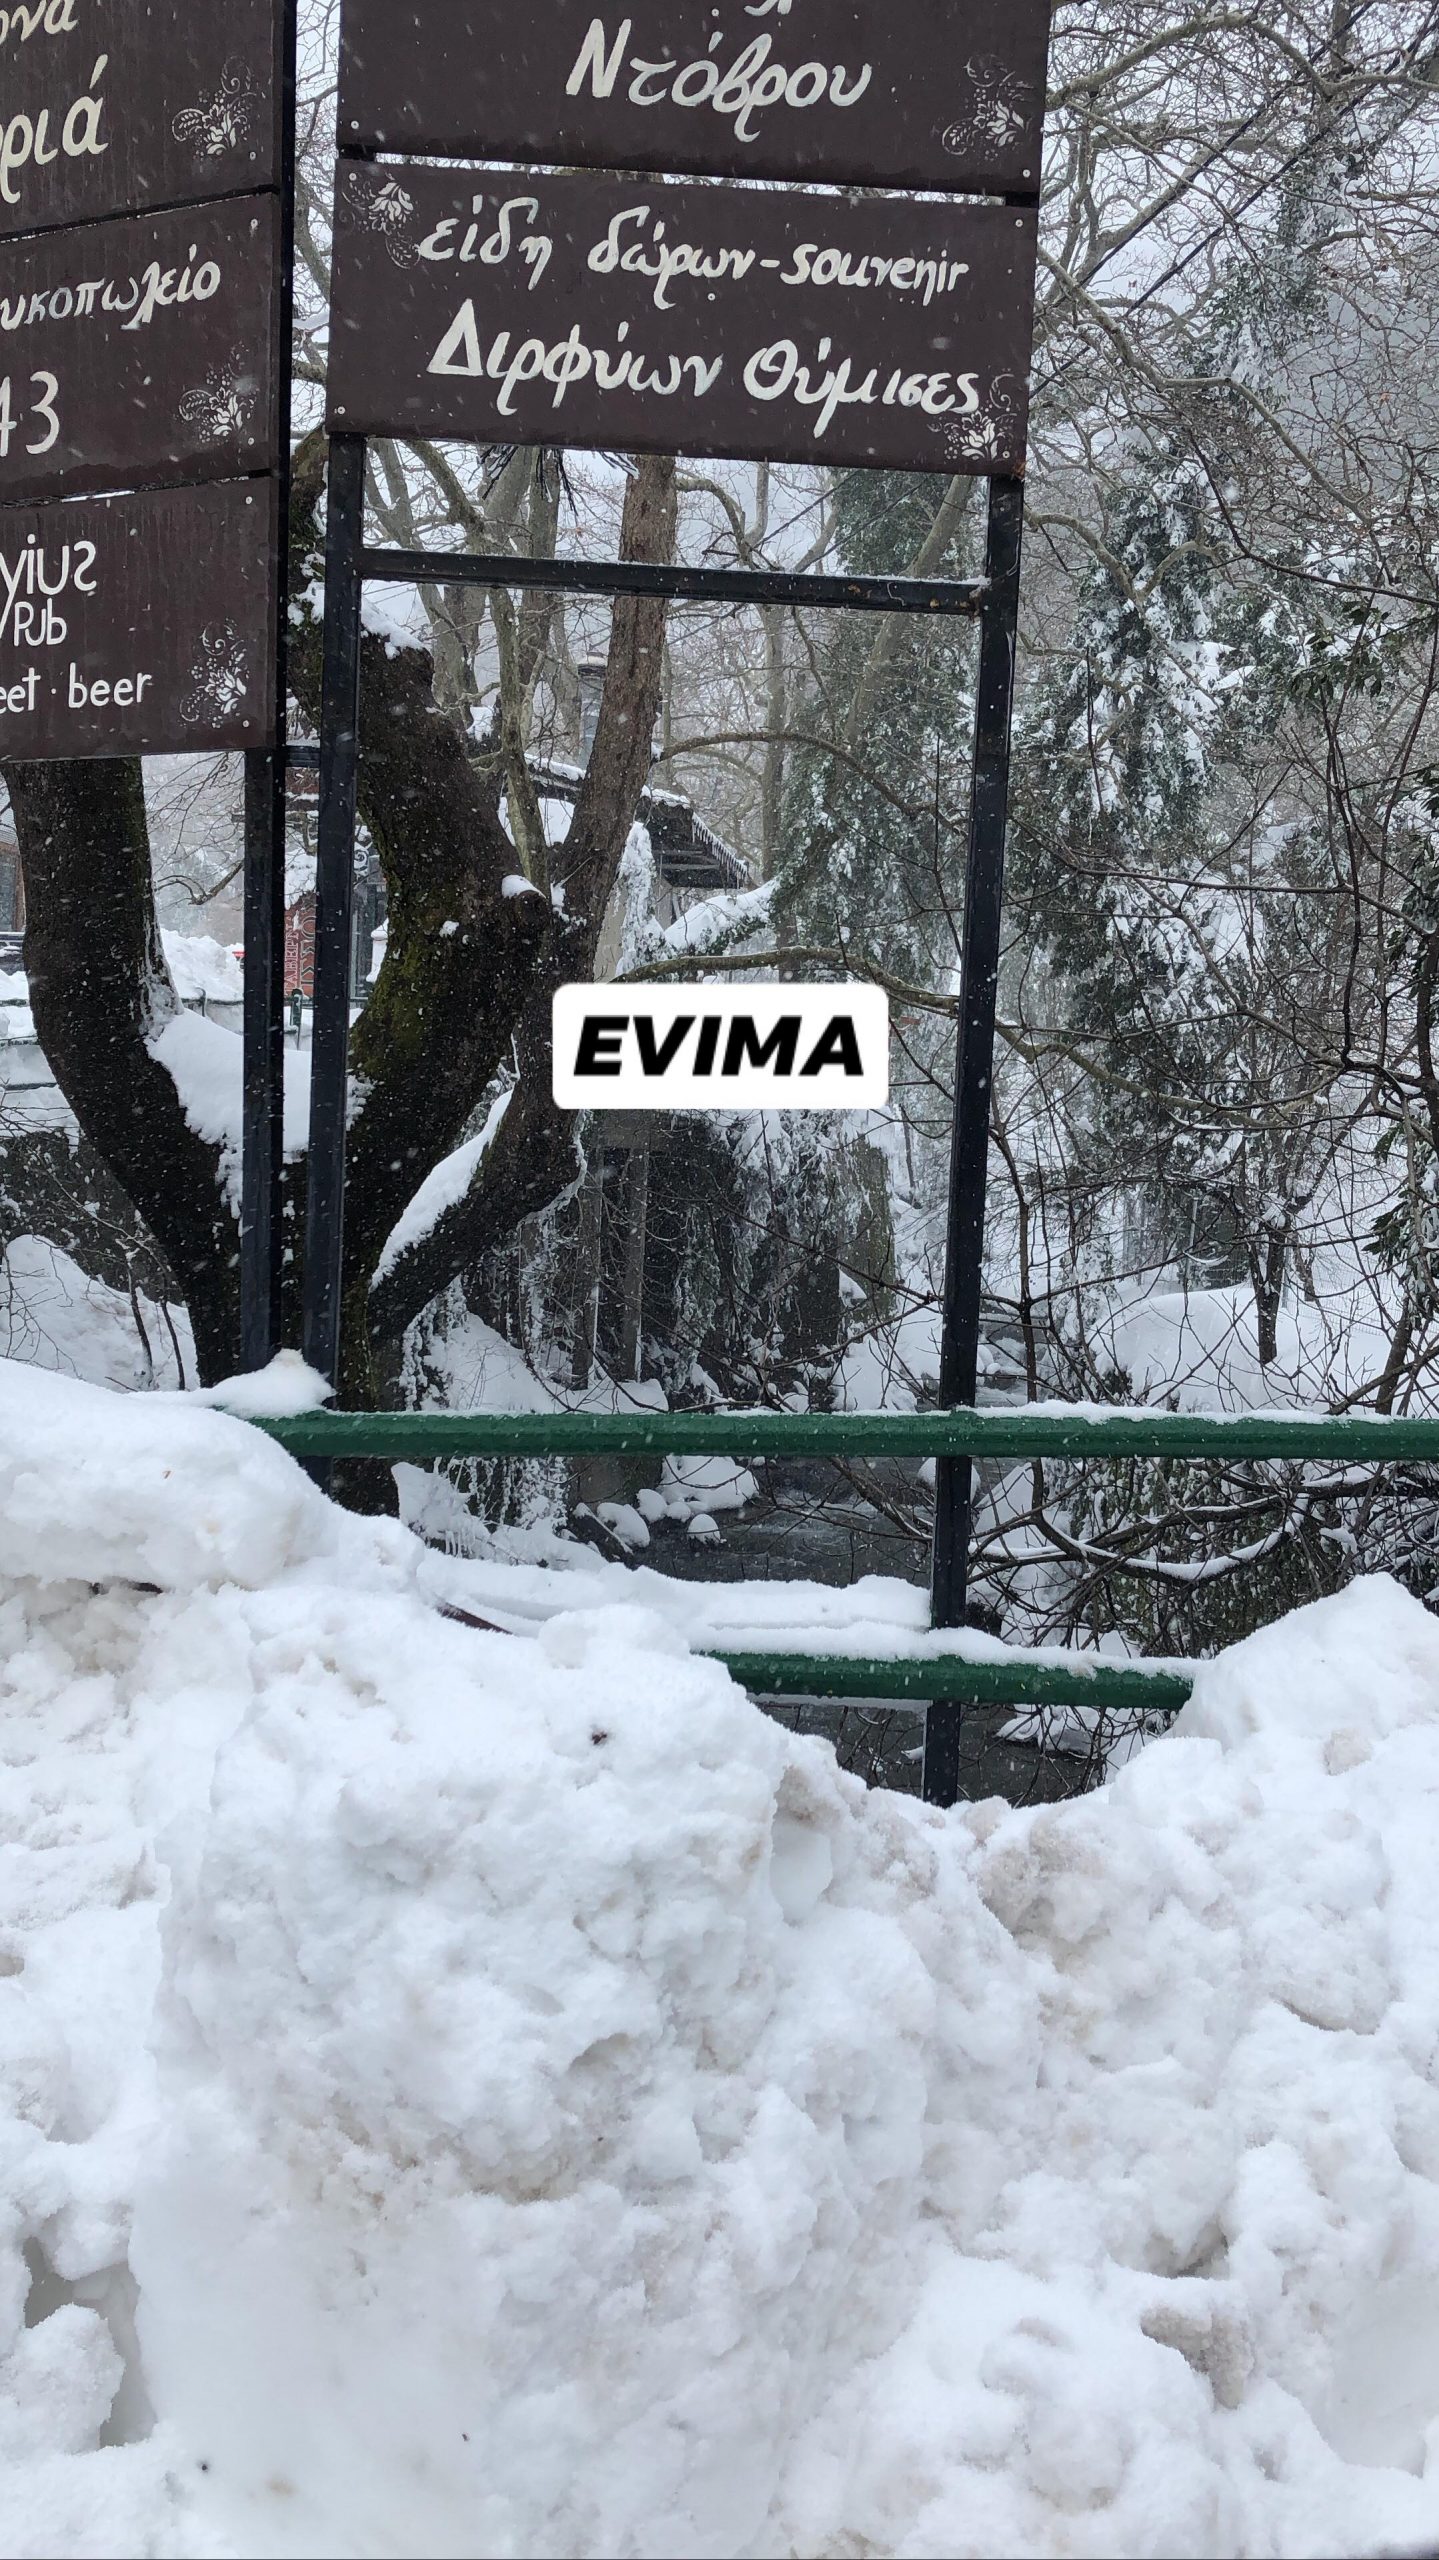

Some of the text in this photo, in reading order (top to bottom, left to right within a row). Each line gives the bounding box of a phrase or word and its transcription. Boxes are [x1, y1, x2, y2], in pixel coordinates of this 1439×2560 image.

[0, 54, 109, 204] ριά
[565, 18, 873, 142] Ντόβρου
[419, 194, 553, 291] είδη
[426, 298, 980, 439] Διρφύων Θύμισες
[68, 662, 152, 708] beer
